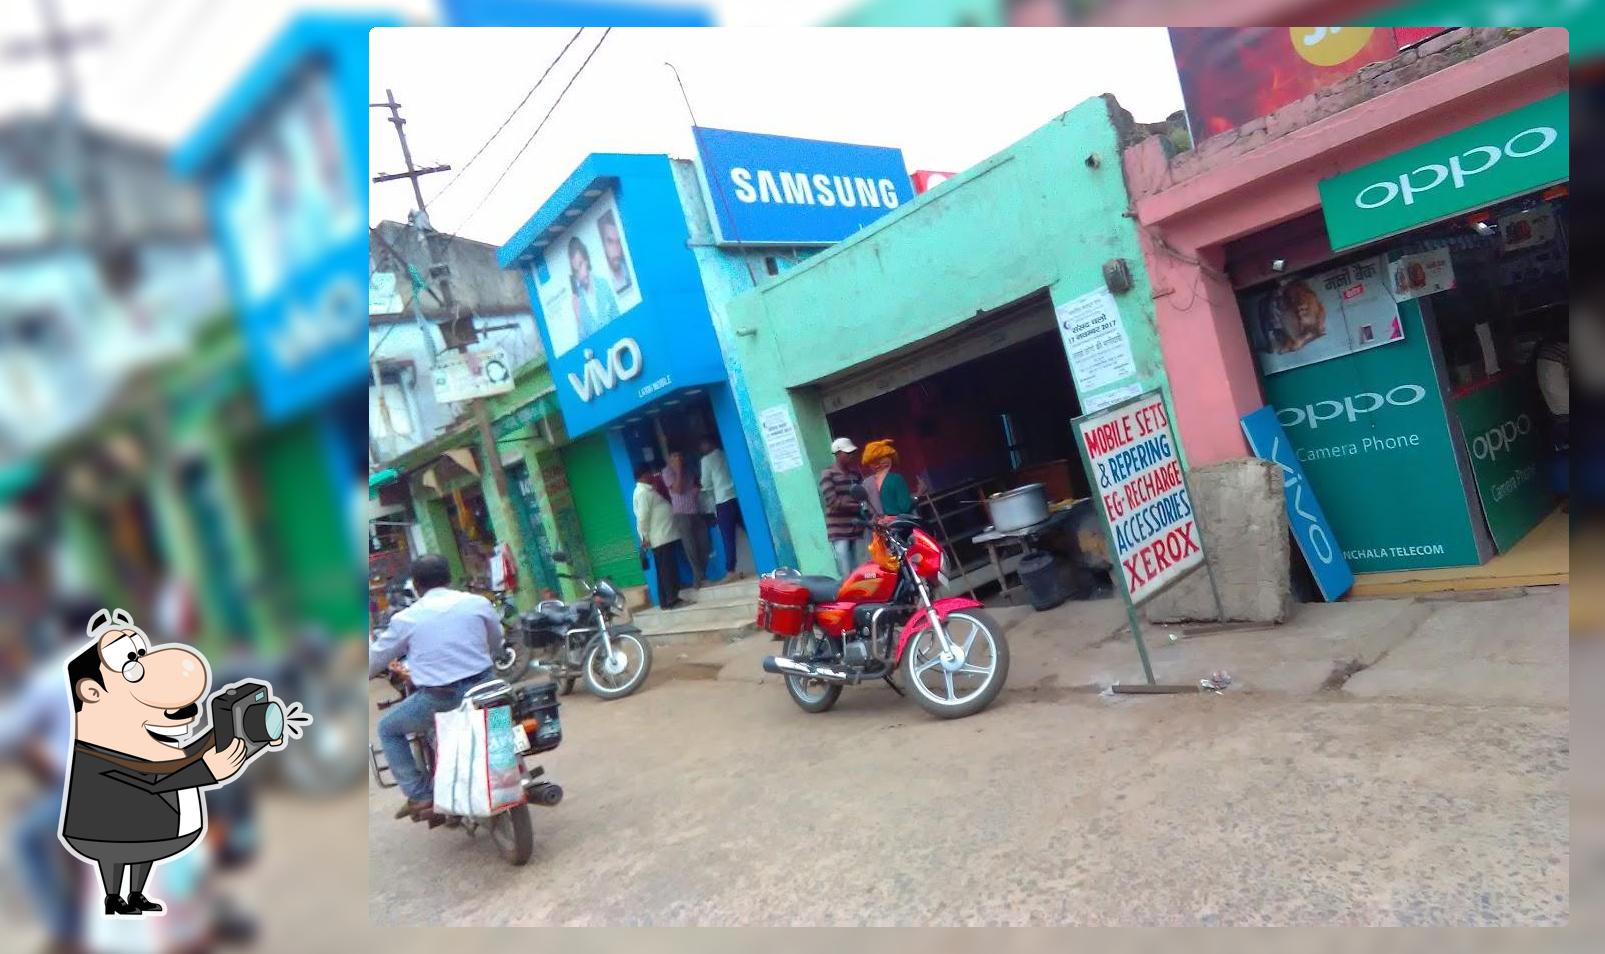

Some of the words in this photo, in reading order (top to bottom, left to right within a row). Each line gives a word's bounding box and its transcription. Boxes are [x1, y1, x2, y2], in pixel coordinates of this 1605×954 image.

[730, 167, 899, 209] SAMSUNG
[1355, 126, 1558, 206] oppo
[1102, 319, 1117, 331] 2017
[568, 337, 643, 402] vivo
[1084, 415, 1133, 459] MOBILE
[1135, 402, 1168, 437] SETS
[1275, 384, 1426, 429] oppo
[1108, 434, 1172, 484] REPERING
[1296, 442, 1358, 463] Camera
[1361, 433, 1420, 453] Phone
[1473, 414, 1531, 461] oppo
[1115, 489, 1191, 556] ACCESSORIES
[1272, 436, 1333, 565] vivo
[1123, 521, 1200, 594] XEROX
[1343, 548, 1388, 560] NCHALA
[1389, 544, 1445, 558] TELECOM
